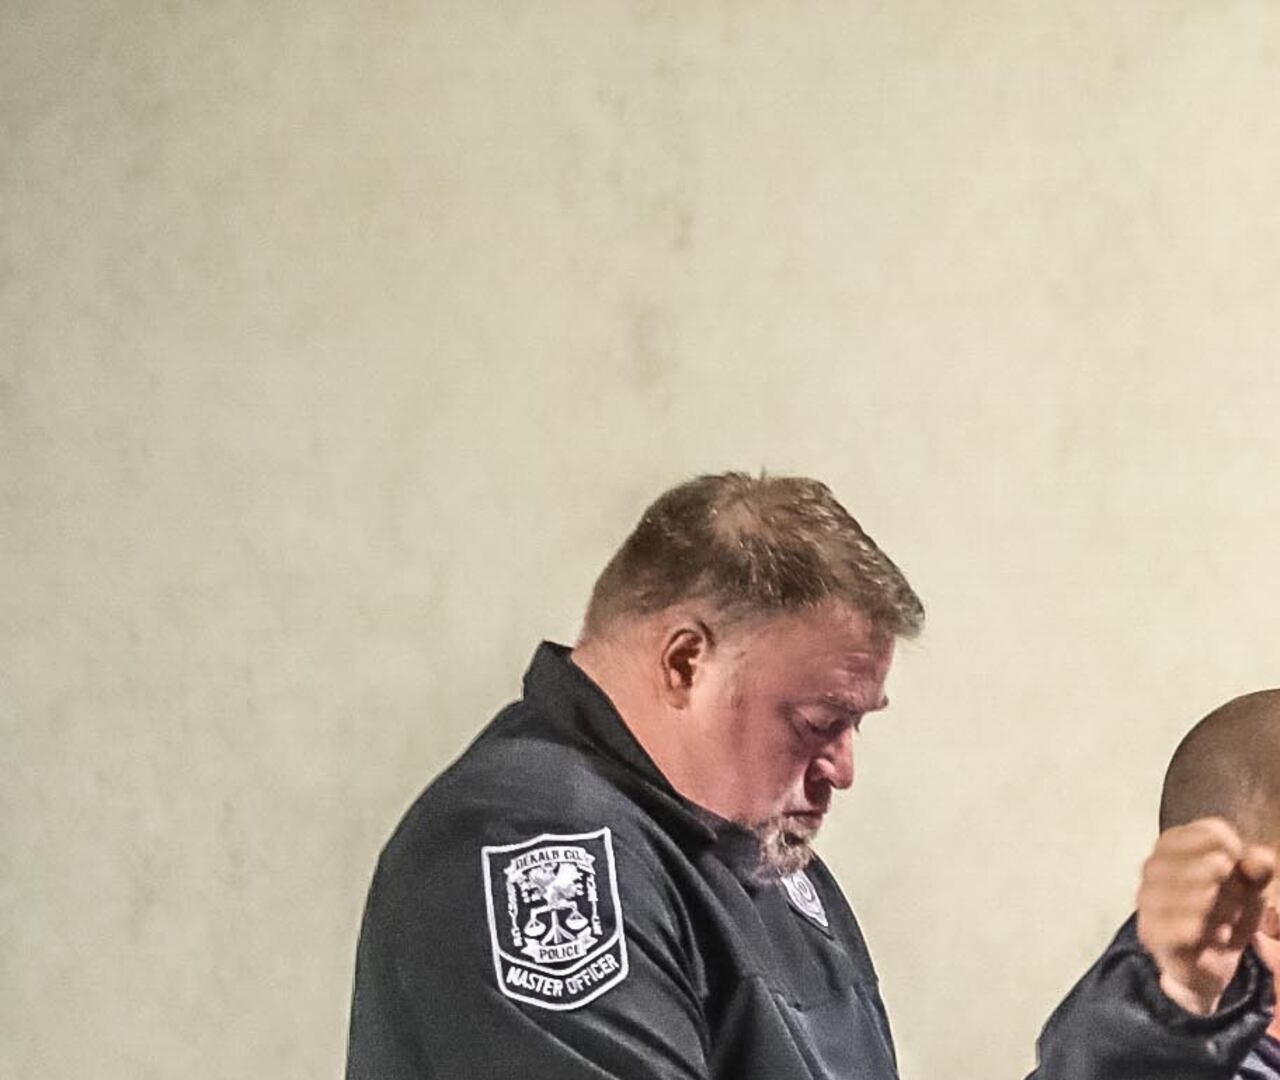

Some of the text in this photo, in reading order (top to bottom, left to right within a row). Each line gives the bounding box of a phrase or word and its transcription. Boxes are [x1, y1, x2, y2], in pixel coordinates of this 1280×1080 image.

[539, 944, 580, 960] POLICE
[506, 953, 620, 997] MASTER OFFICER
